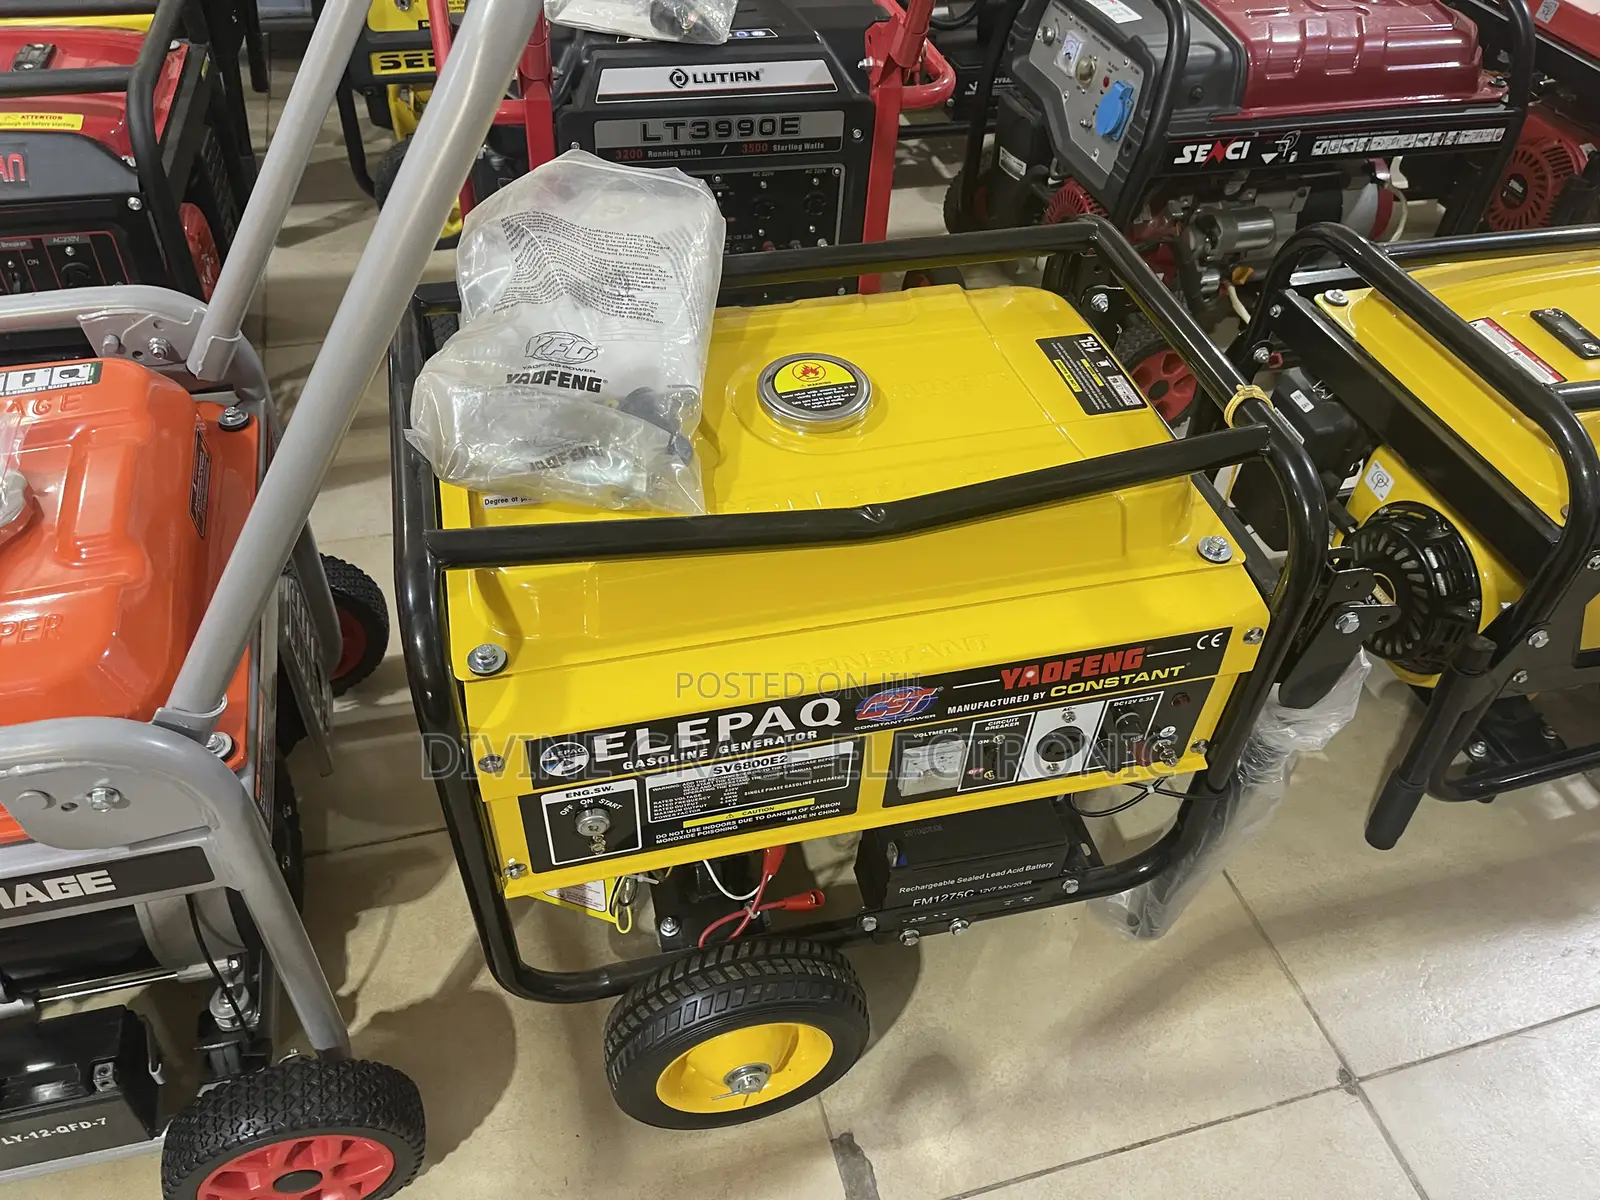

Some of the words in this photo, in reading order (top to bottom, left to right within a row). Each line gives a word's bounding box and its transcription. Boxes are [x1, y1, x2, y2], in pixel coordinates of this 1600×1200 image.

[693, 70, 760, 84] LUTIAN
[640, 115, 801, 143] LT3990E
[616, 150, 643, 160] 3200
[648, 148, 679, 158] Running
[681, 148, 701, 157] Watts
[742, 143, 768, 154] 3500
[773, 143, 803, 153] Starting
[805, 141, 824, 151] Watts
[1173, 136, 1251, 168] SENCI
[1078, 336, 1101, 353] 15L
[562, 366, 597, 374] POWER
[506, 369, 603, 394] YAOFENG
[485, 498, 509, 506] Degree
[1000, 647, 1147, 690] YAOFENG
[1196, 632, 1224, 650] CE
[947, 694, 1031, 715] MANUFACTURED
[1033, 691, 1046, 700] BY
[1049, 664, 1186, 698] CONSTANT
[1113, 698, 1138, 707] DC12V
[593, 697, 842, 763] ELEPAQ
[854, 718, 904, 731] CONSTANT
[904, 713, 936, 722] POWER
[984, 721, 1020, 731] BREAKER
[987, 717, 1019, 727] CIRCUIT
[913, 727, 959, 739] VOLTMETER
[622, 749, 708, 771] GASOLINE
[718, 729, 818, 754] GENERATOR
[713, 755, 788, 776] SV6800E2
[565, 785, 615, 798] ENG.SW.
[744, 788, 765, 796] SINGLE
[765, 785, 784, 793] PHASE
[784, 780, 812, 789] GASOLINE
[813, 774, 845, 784] GENERATOR
[675, 793, 702, 802] VOLTAGE
[675, 796, 711, 805] FREQUENCY
[675, 801, 700, 809] OUTPUT
[560, 804, 575, 816] OFF
[580, 798, 594, 806] ON
[598, 798, 623, 810] START
[653, 809, 685, 817] MAXIMUM
[677, 808, 701, 816] FACTOR
[741, 806, 775, 816] CAUTION
[787, 814, 808, 822] MADE
[817, 808, 841, 816] CHINA
[669, 830, 685, 838] NOT
[703, 820, 737, 832] INDOORS
[738, 817, 753, 825] DUE
[766, 808, 799, 820] DANGER
[809, 801, 841, 811] CARBON
[655, 832, 696, 845] MONOXIDE
[697, 825, 739, 837] POISONING
[899, 878, 956, 894] Rechargeable
[956, 873, 985, 884] Sealed
[986, 870, 1006, 879] Lead
[1006, 867, 1025, 875] Acid
[1025, 861, 1055, 872] Battery
[1, 1117, 107, 1146] LY-12-QFD-7
